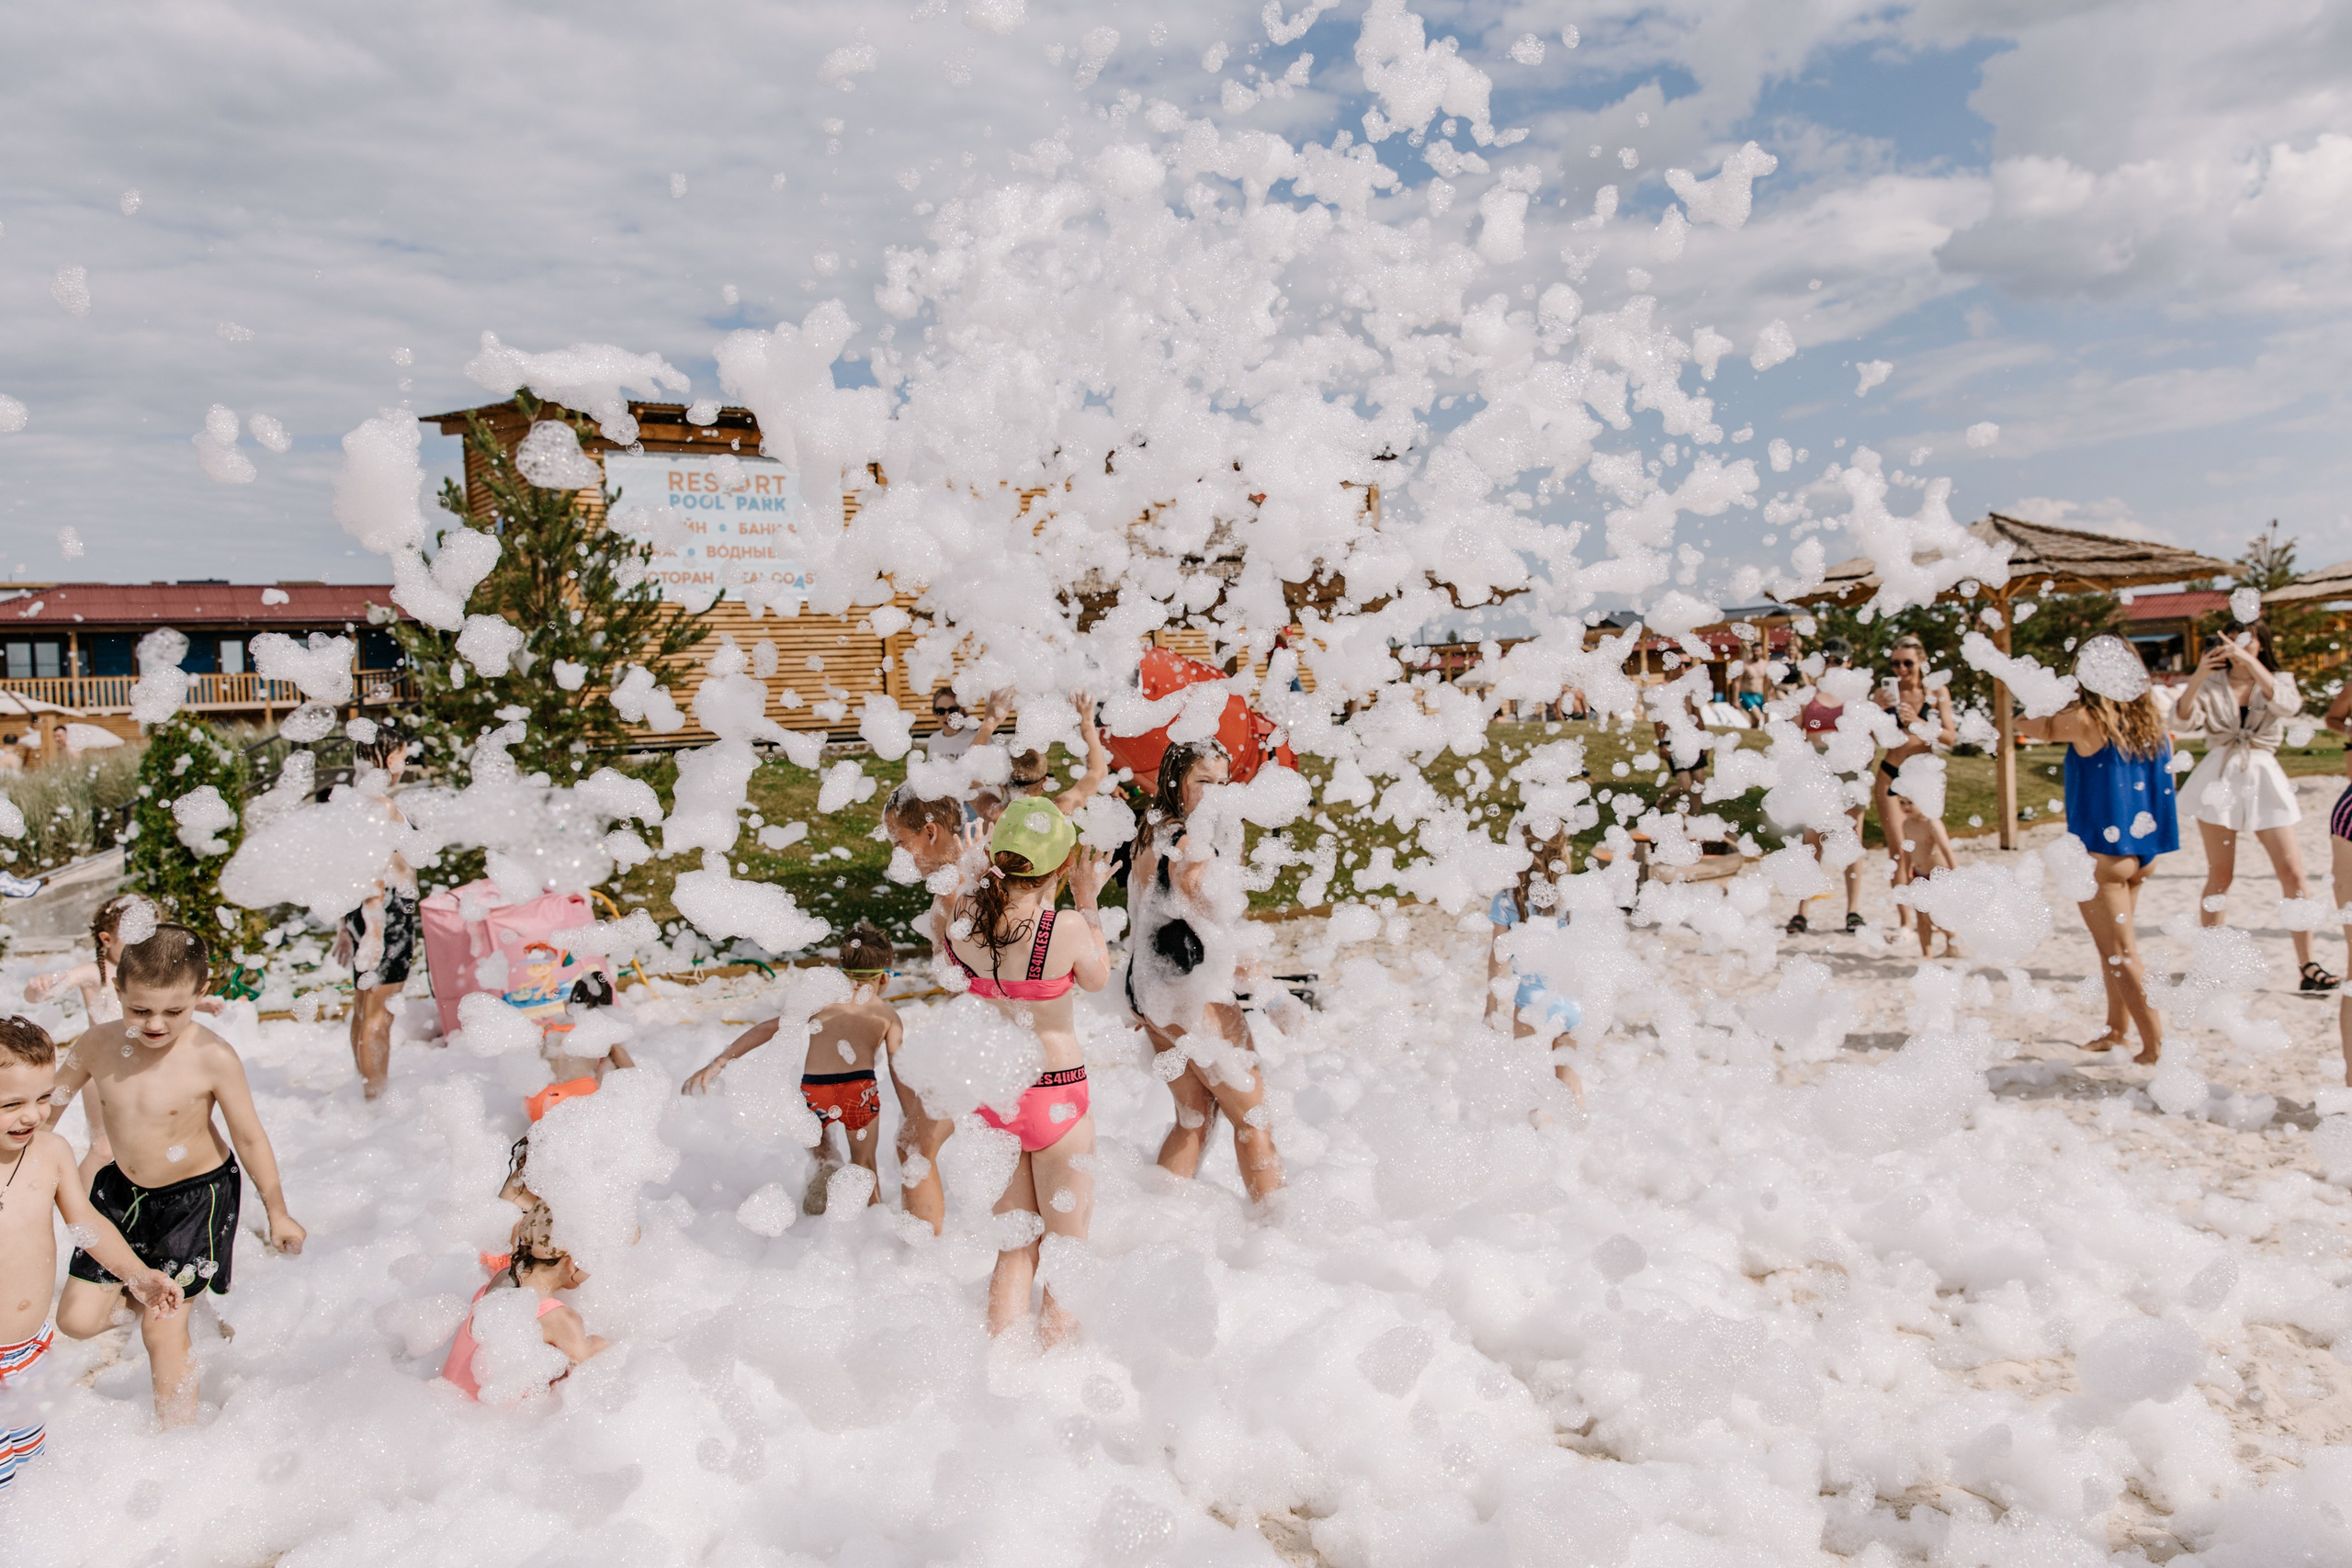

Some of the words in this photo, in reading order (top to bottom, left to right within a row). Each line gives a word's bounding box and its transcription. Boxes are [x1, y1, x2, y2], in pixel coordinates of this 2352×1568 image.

[669, 494, 726, 510] POOL
[736, 496, 786, 512] PARK
[644, 571, 715, 585] СТОРАН
[771, 571, 817, 590] COAS
